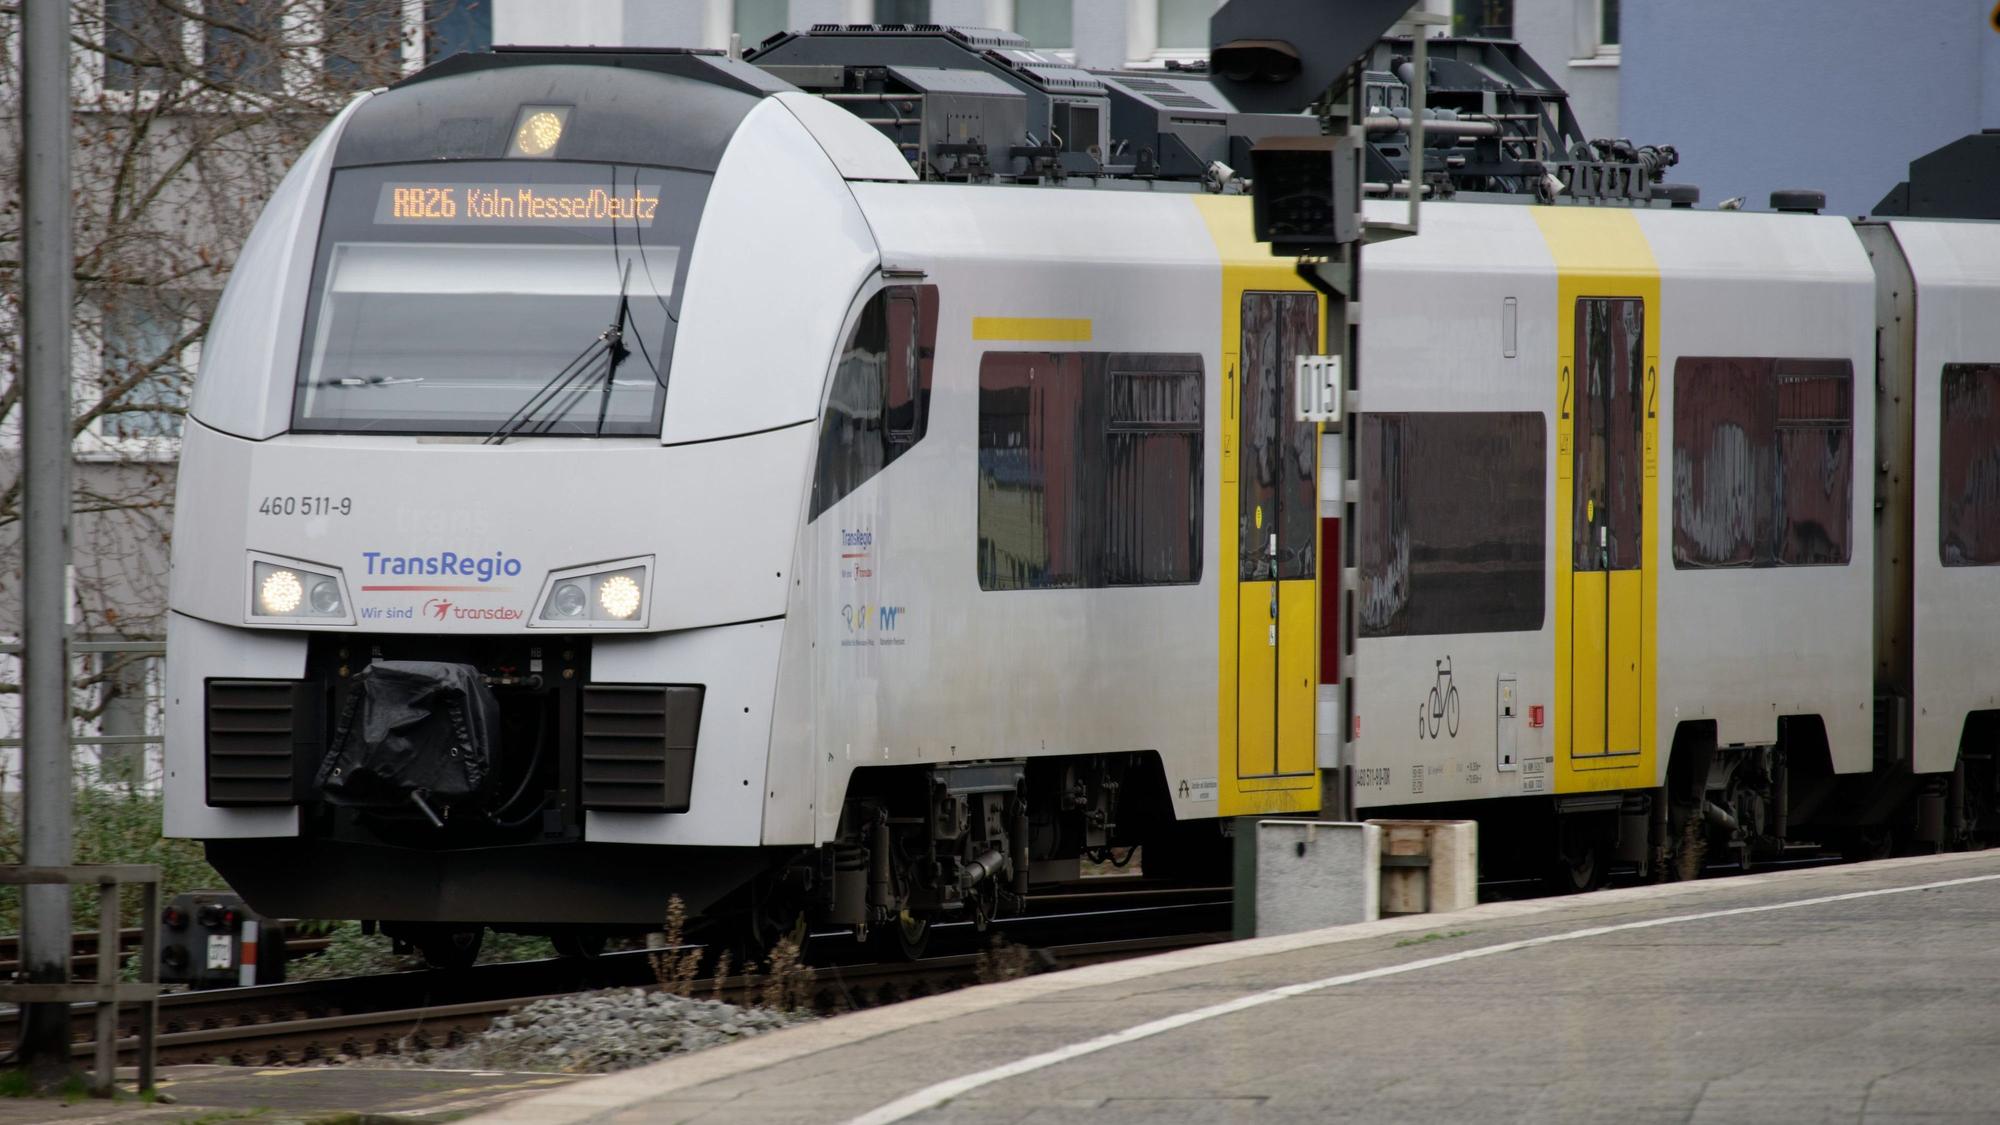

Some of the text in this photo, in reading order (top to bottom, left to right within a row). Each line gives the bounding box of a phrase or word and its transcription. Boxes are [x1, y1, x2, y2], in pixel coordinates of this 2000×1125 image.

[394, 188, 659, 218] RB26 Köln Messe/Deutz
[1302, 362, 1335, 414] 015
[1562, 366, 1570, 419] 2
[1648, 366, 1656, 418] 2
[259, 496, 352, 515] 460 511-9
[363, 551, 522, 582] TransRegio
[361, 606, 413, 619] Wir sind
[454, 606, 523, 620] transdev
[1419, 703, 1425, 740] 6
